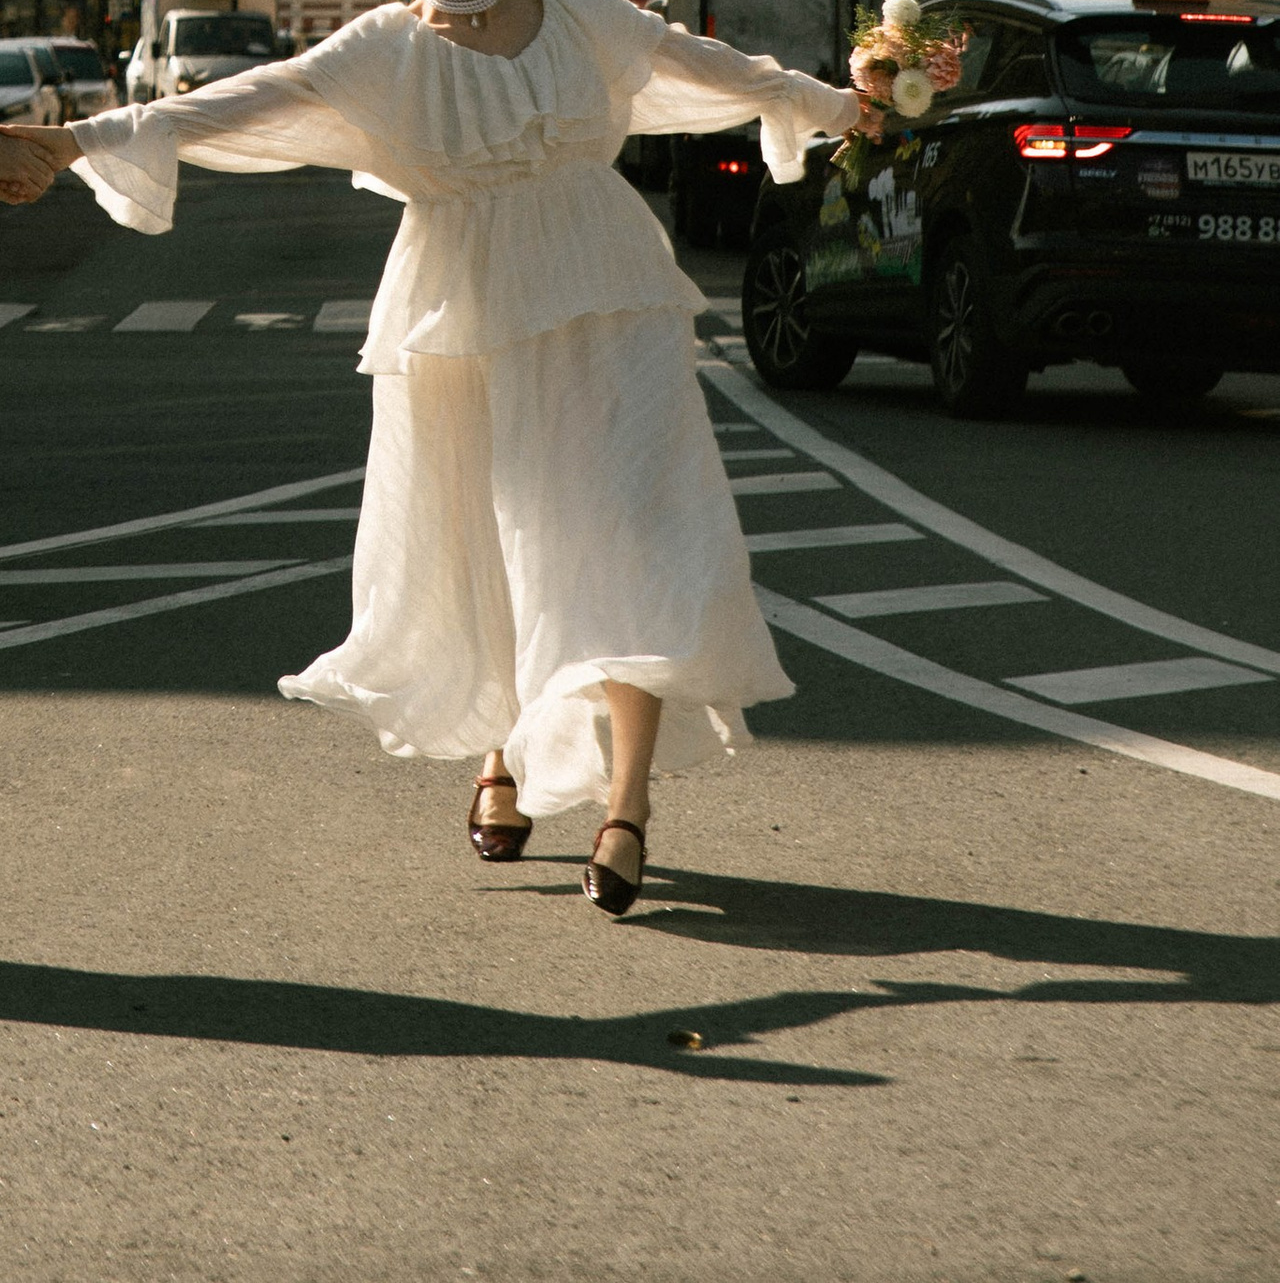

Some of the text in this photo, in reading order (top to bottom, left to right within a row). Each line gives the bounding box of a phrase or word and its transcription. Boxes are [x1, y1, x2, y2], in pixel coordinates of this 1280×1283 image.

[1163, 214, 1192, 227] (812)
[1198, 214, 1252, 241] 988
[1258, 216, 1280, 242] 8
